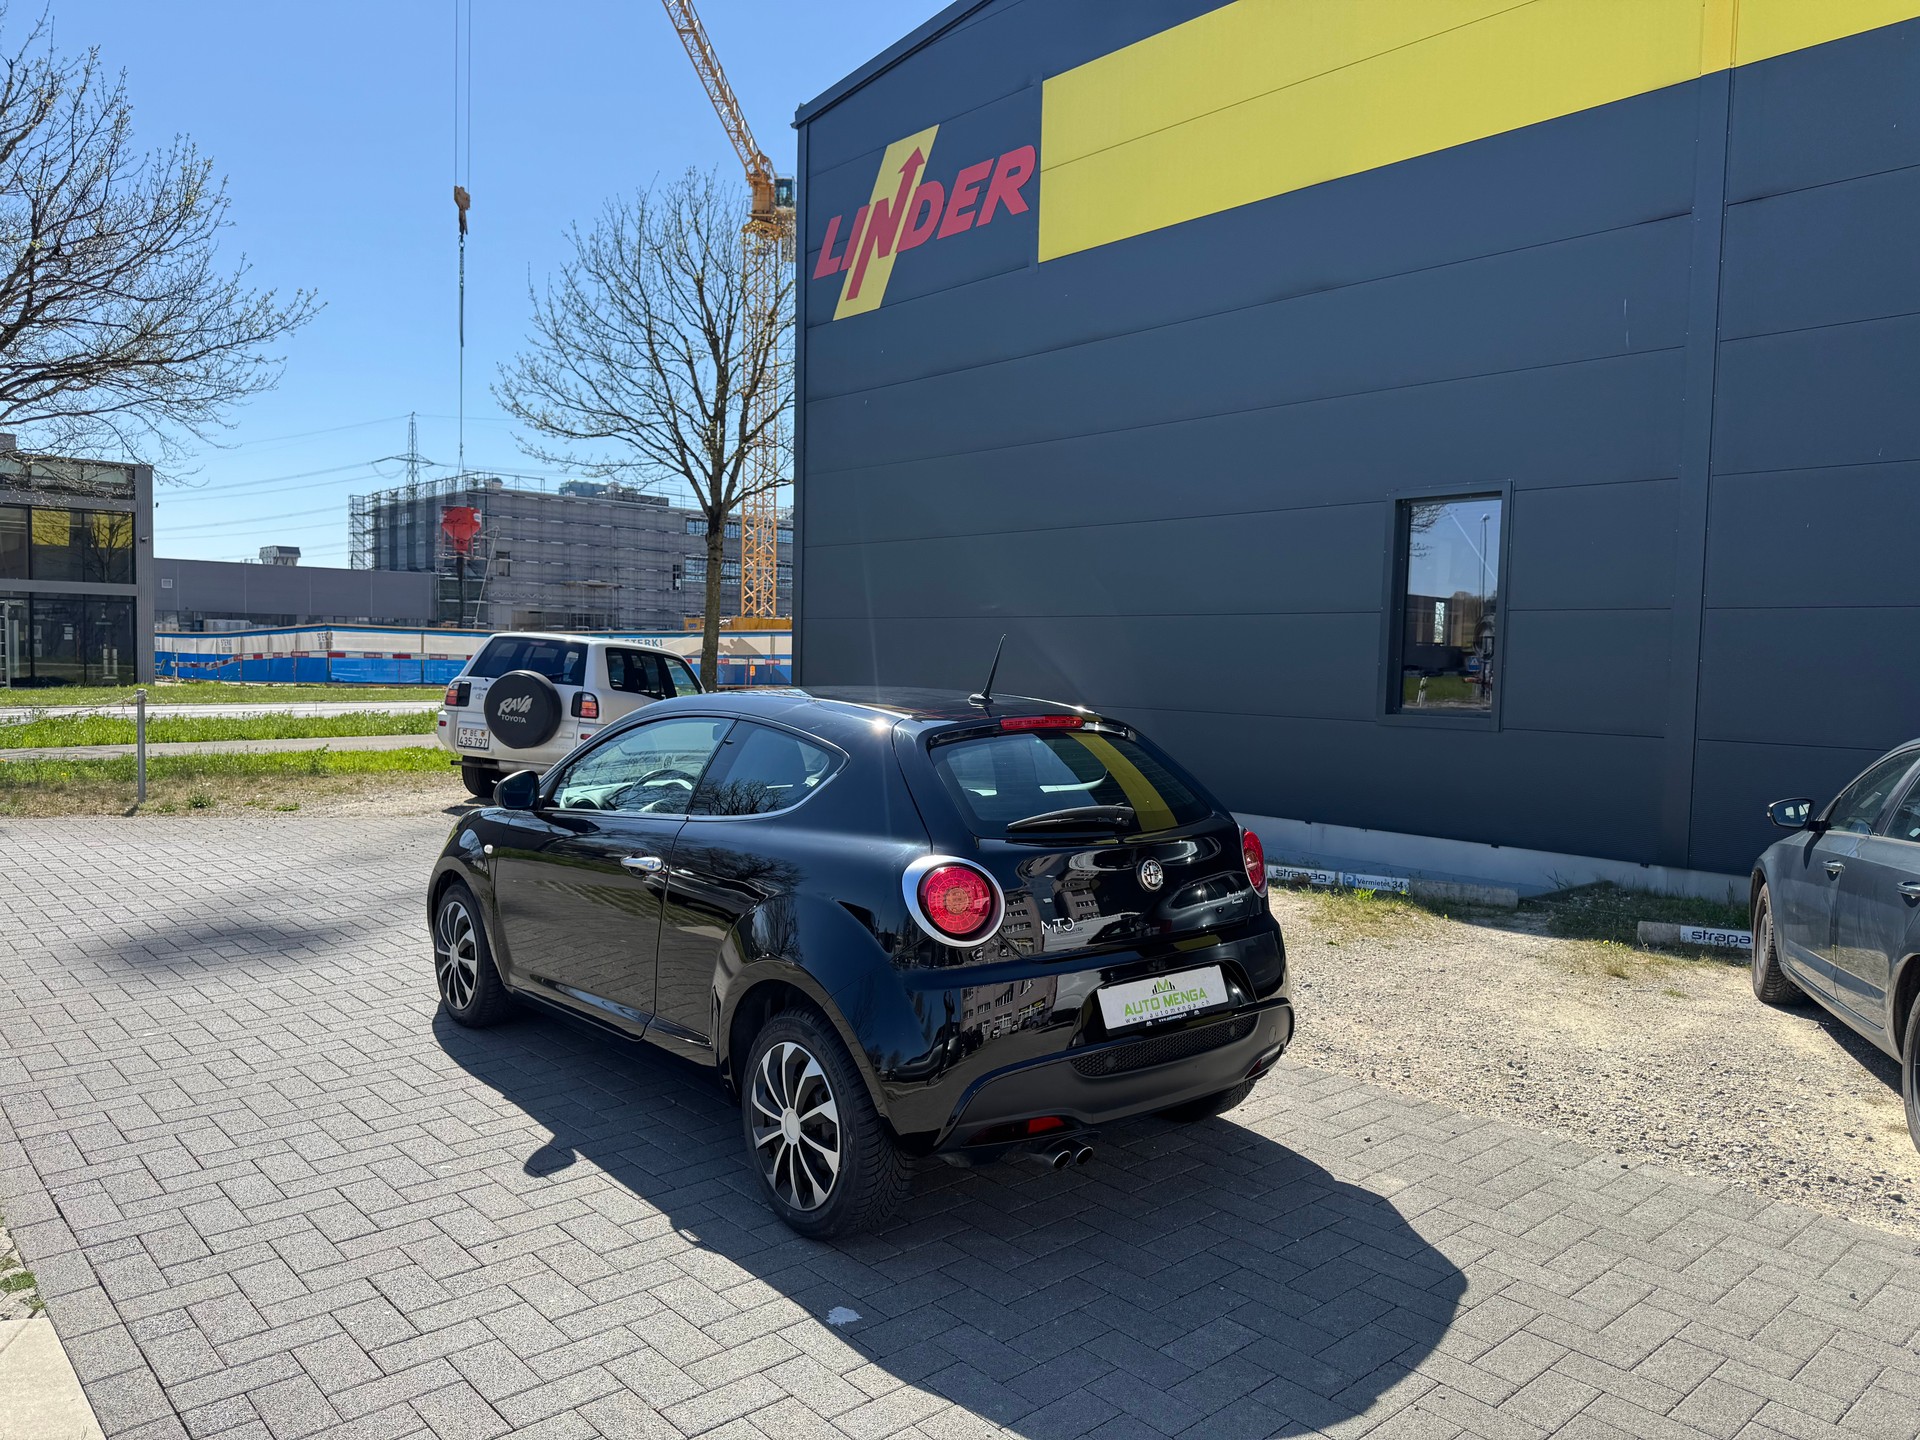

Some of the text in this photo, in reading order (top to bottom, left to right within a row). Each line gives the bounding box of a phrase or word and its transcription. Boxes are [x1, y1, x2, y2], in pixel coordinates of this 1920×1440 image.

[813, 145, 1036, 301] LINDER
[501, 714, 527, 724] TOYOTA
[1691, 930, 1752, 945] strapa
[1124, 987, 1208, 1016] AUTO MENGA
